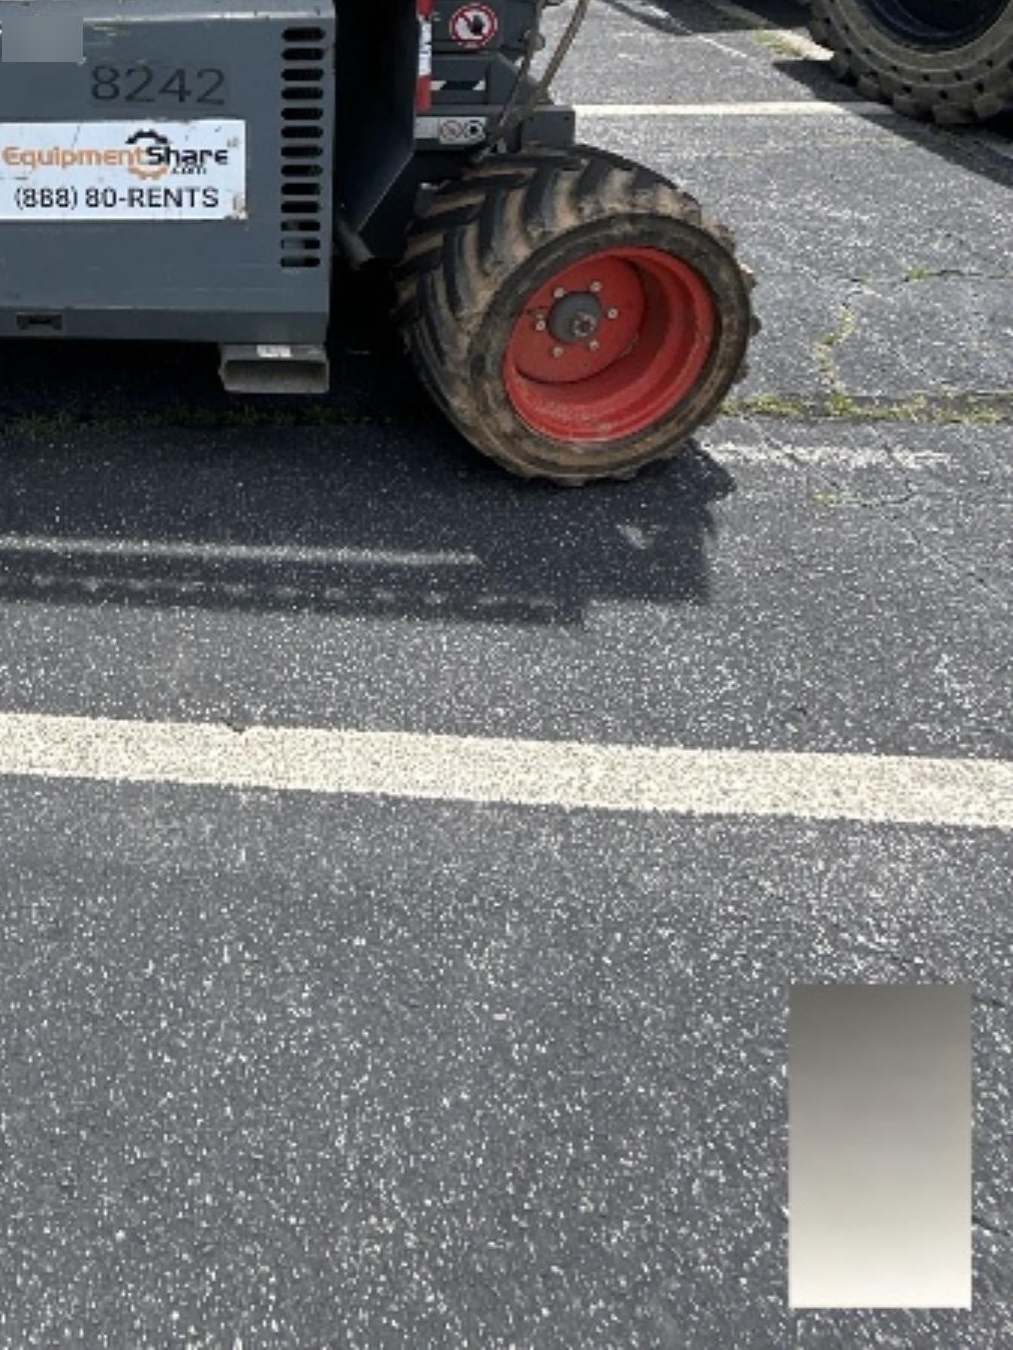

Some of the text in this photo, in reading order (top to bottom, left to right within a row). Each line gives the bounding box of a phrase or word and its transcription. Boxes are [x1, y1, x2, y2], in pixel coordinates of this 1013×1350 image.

[91, 65, 226, 105] 8242
[2, 145, 229, 168] EquipmentShare
[14, 186, 220, 210] (888) 80-RENTS
